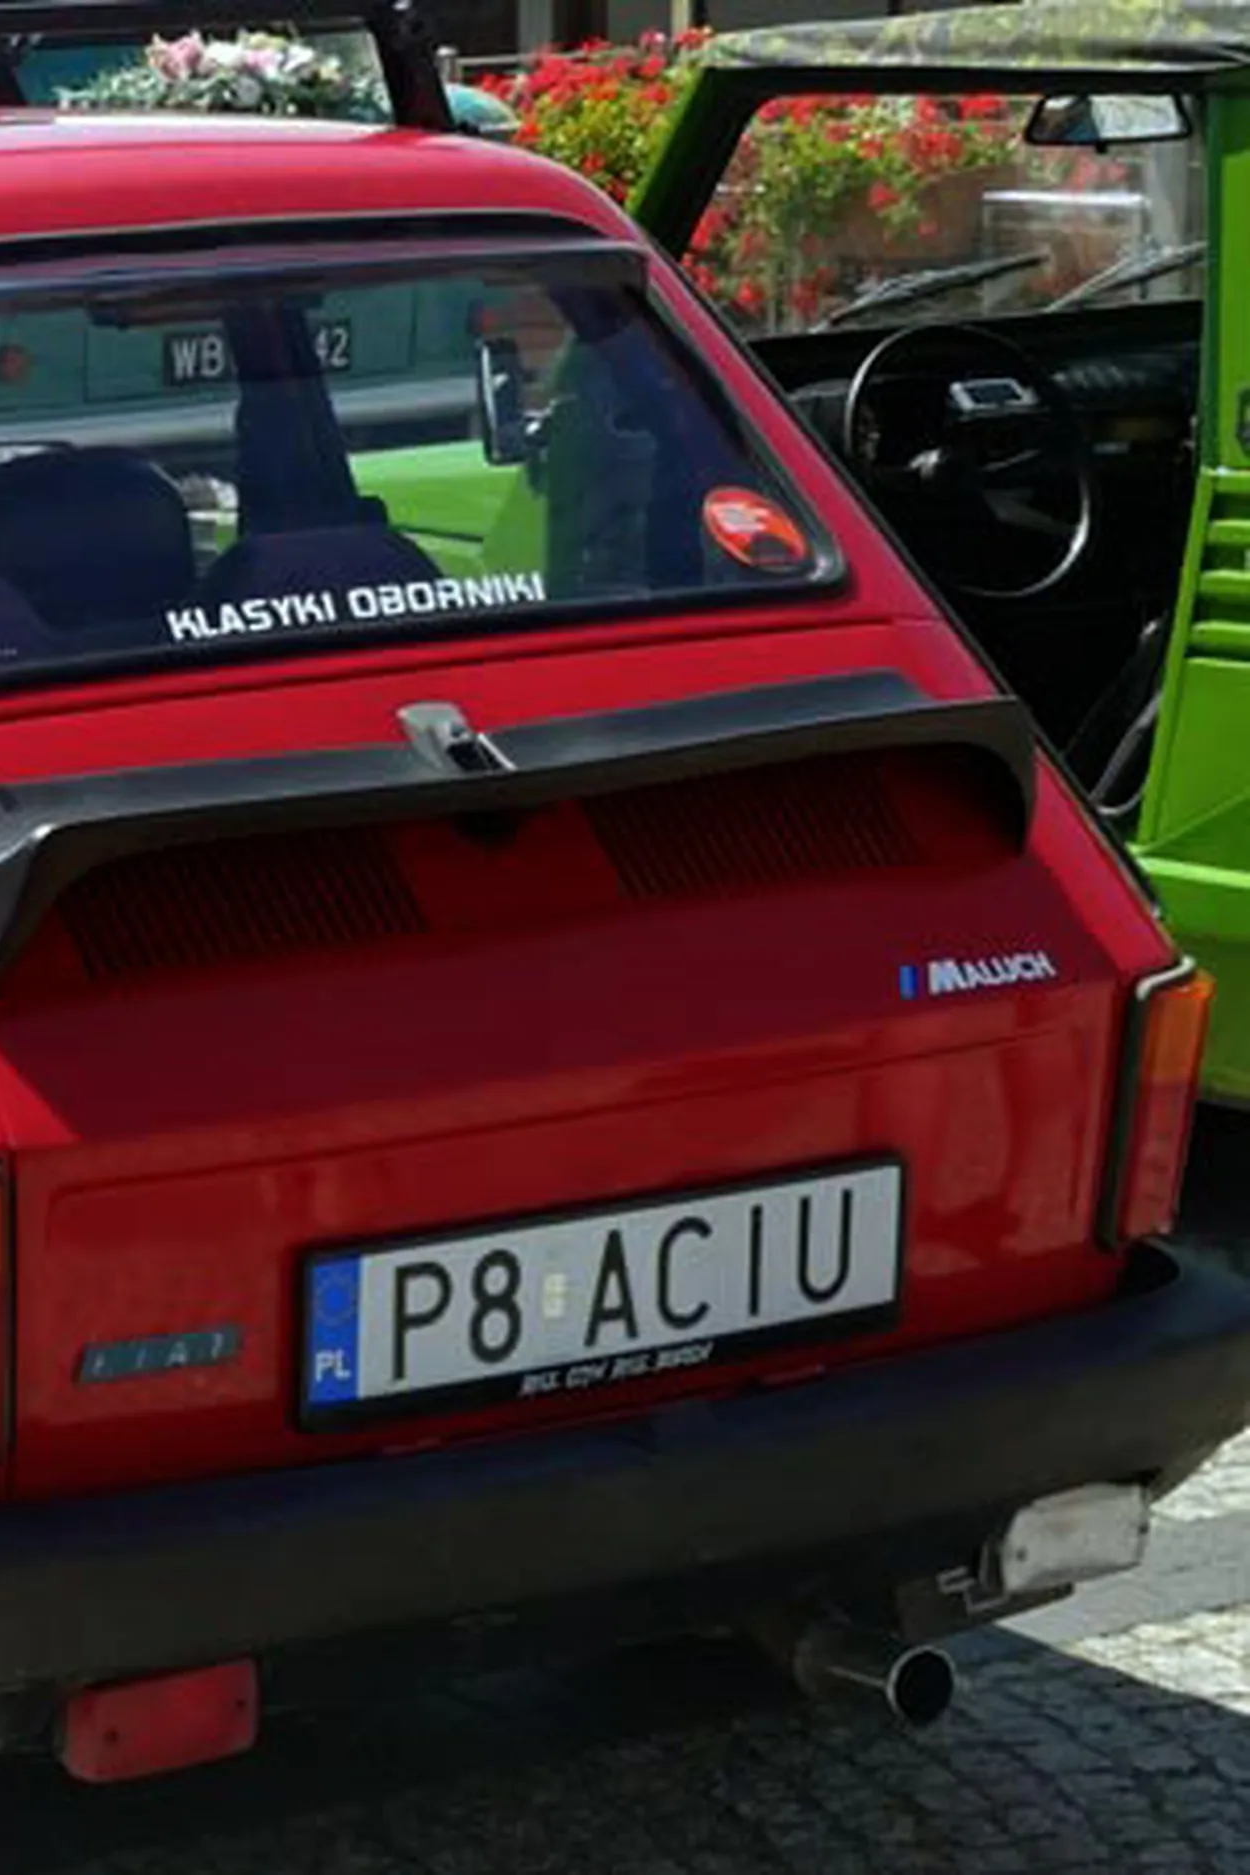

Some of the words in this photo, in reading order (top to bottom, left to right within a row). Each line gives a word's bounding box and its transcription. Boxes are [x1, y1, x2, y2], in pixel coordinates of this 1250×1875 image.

[166, 590, 337, 640] KLASYKI
[348, 571, 546, 619] OBORNIKI
[390, 1247, 524, 1382] P8
[584, 1187, 854, 1348] ACIU
[314, 1349, 352, 1383] PL
